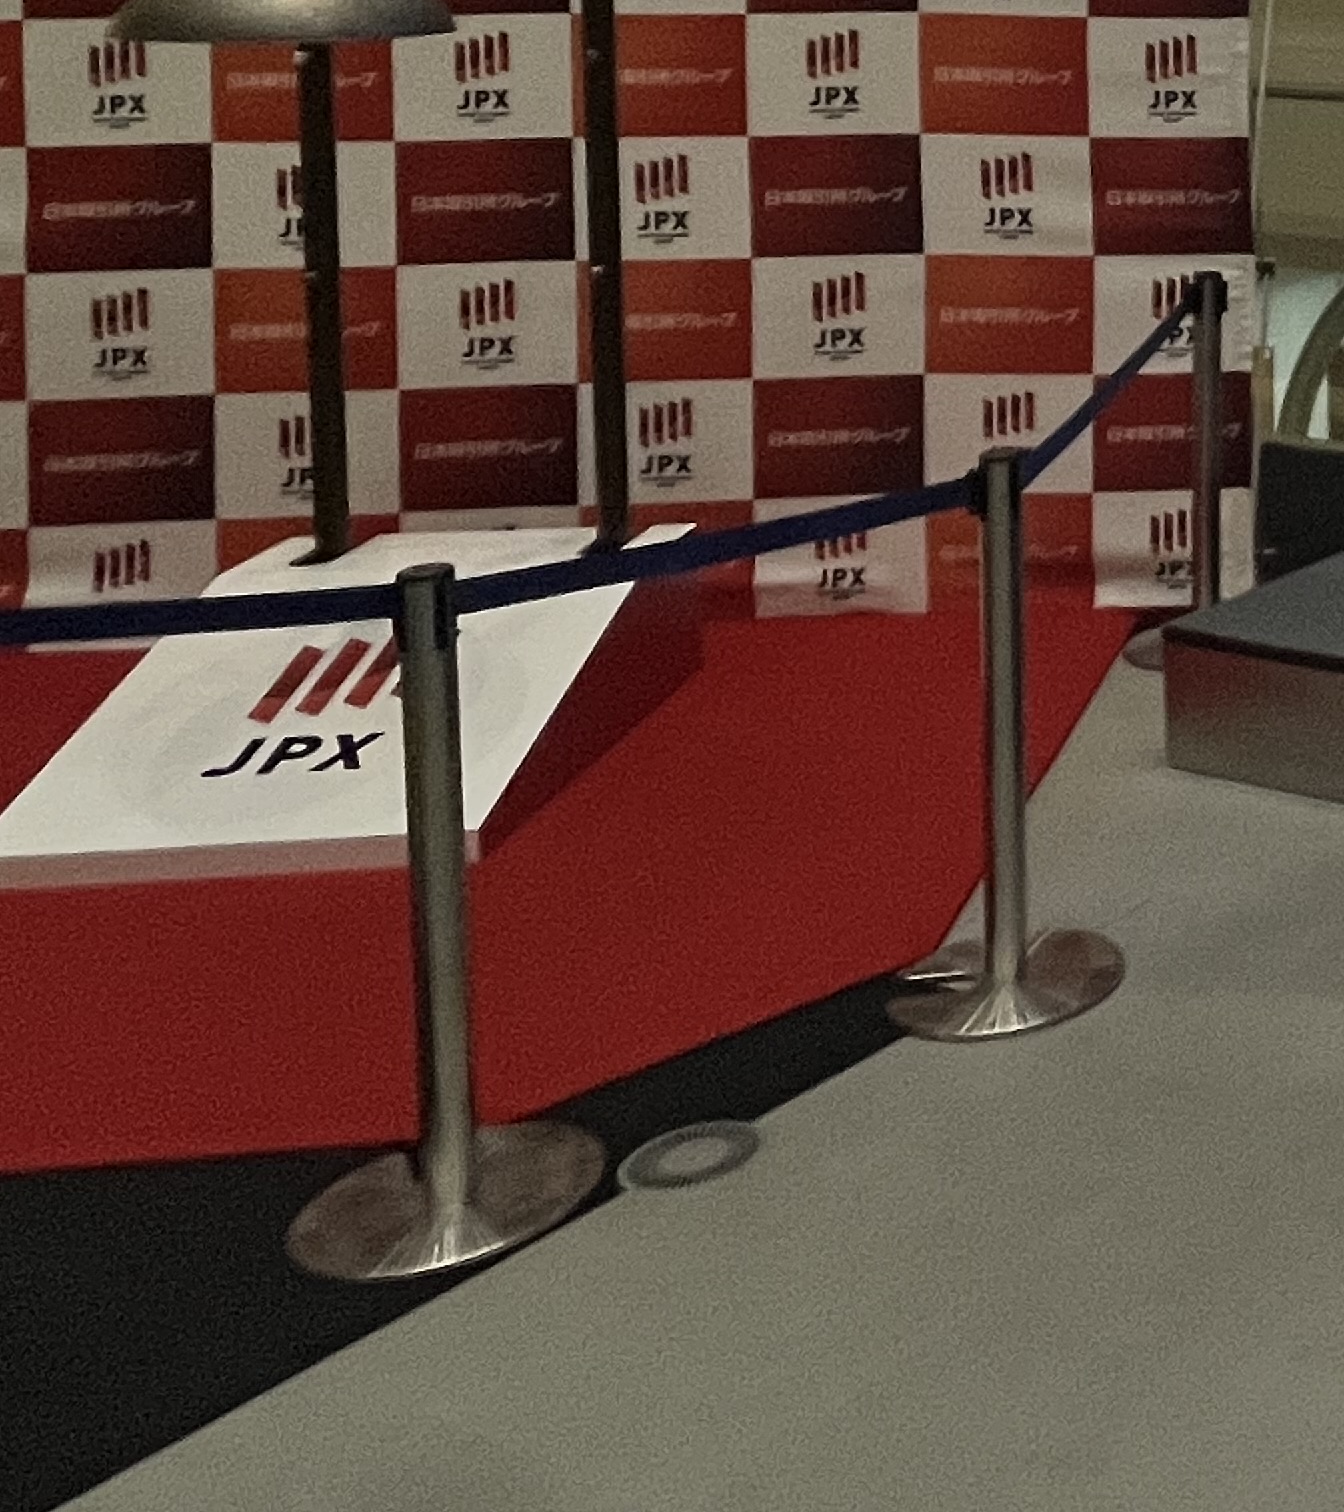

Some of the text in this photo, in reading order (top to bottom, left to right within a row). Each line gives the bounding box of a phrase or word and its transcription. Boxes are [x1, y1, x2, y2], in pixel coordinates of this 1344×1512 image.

[457, 89, 510, 111] JPX
[984, 207, 1033, 228] JPX
[94, 347, 147, 368] JPX
[818, 568, 865, 587] JPX
[201, 732, 384, 777] JPX
